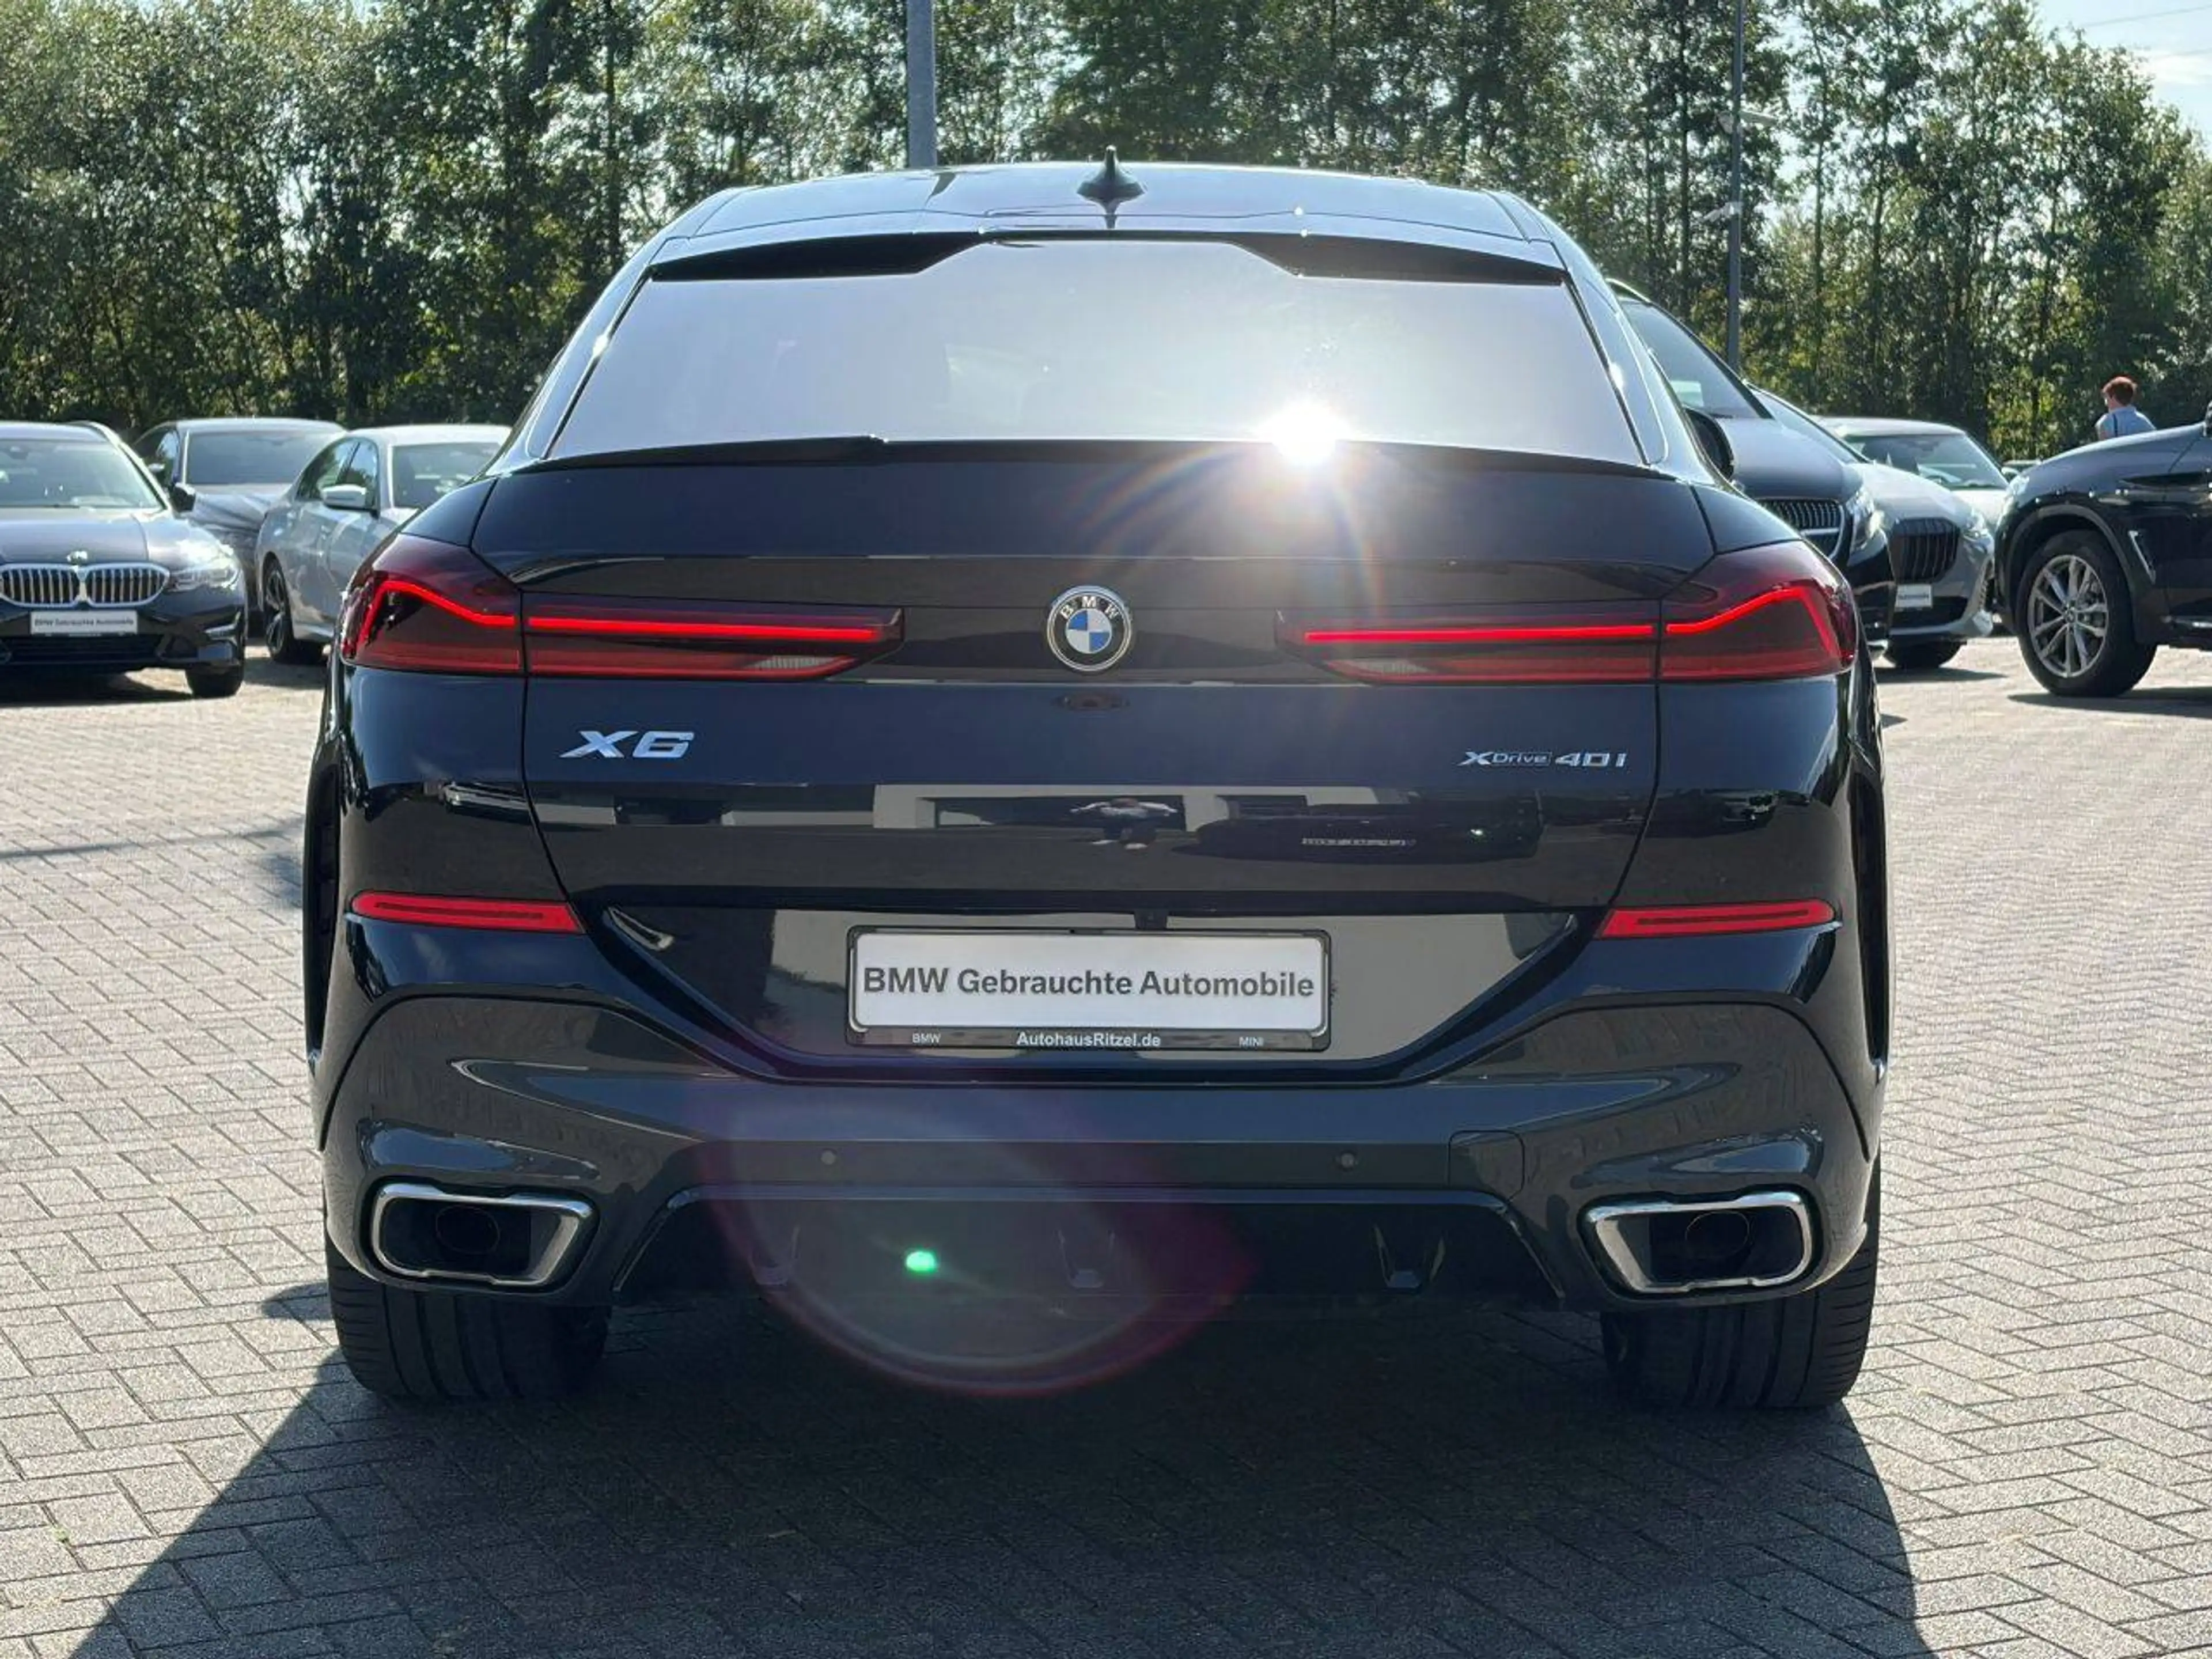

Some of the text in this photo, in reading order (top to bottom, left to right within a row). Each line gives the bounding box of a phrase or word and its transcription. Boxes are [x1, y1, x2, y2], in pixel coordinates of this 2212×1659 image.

[1060, 596, 1119, 619] BMW
[559, 731, 694, 757] X6
[863, 967, 1315, 997] BMW Gebrauchte Automobile
[912, 1032, 1264, 1047] BMW AutohausRitzel.de MINI
